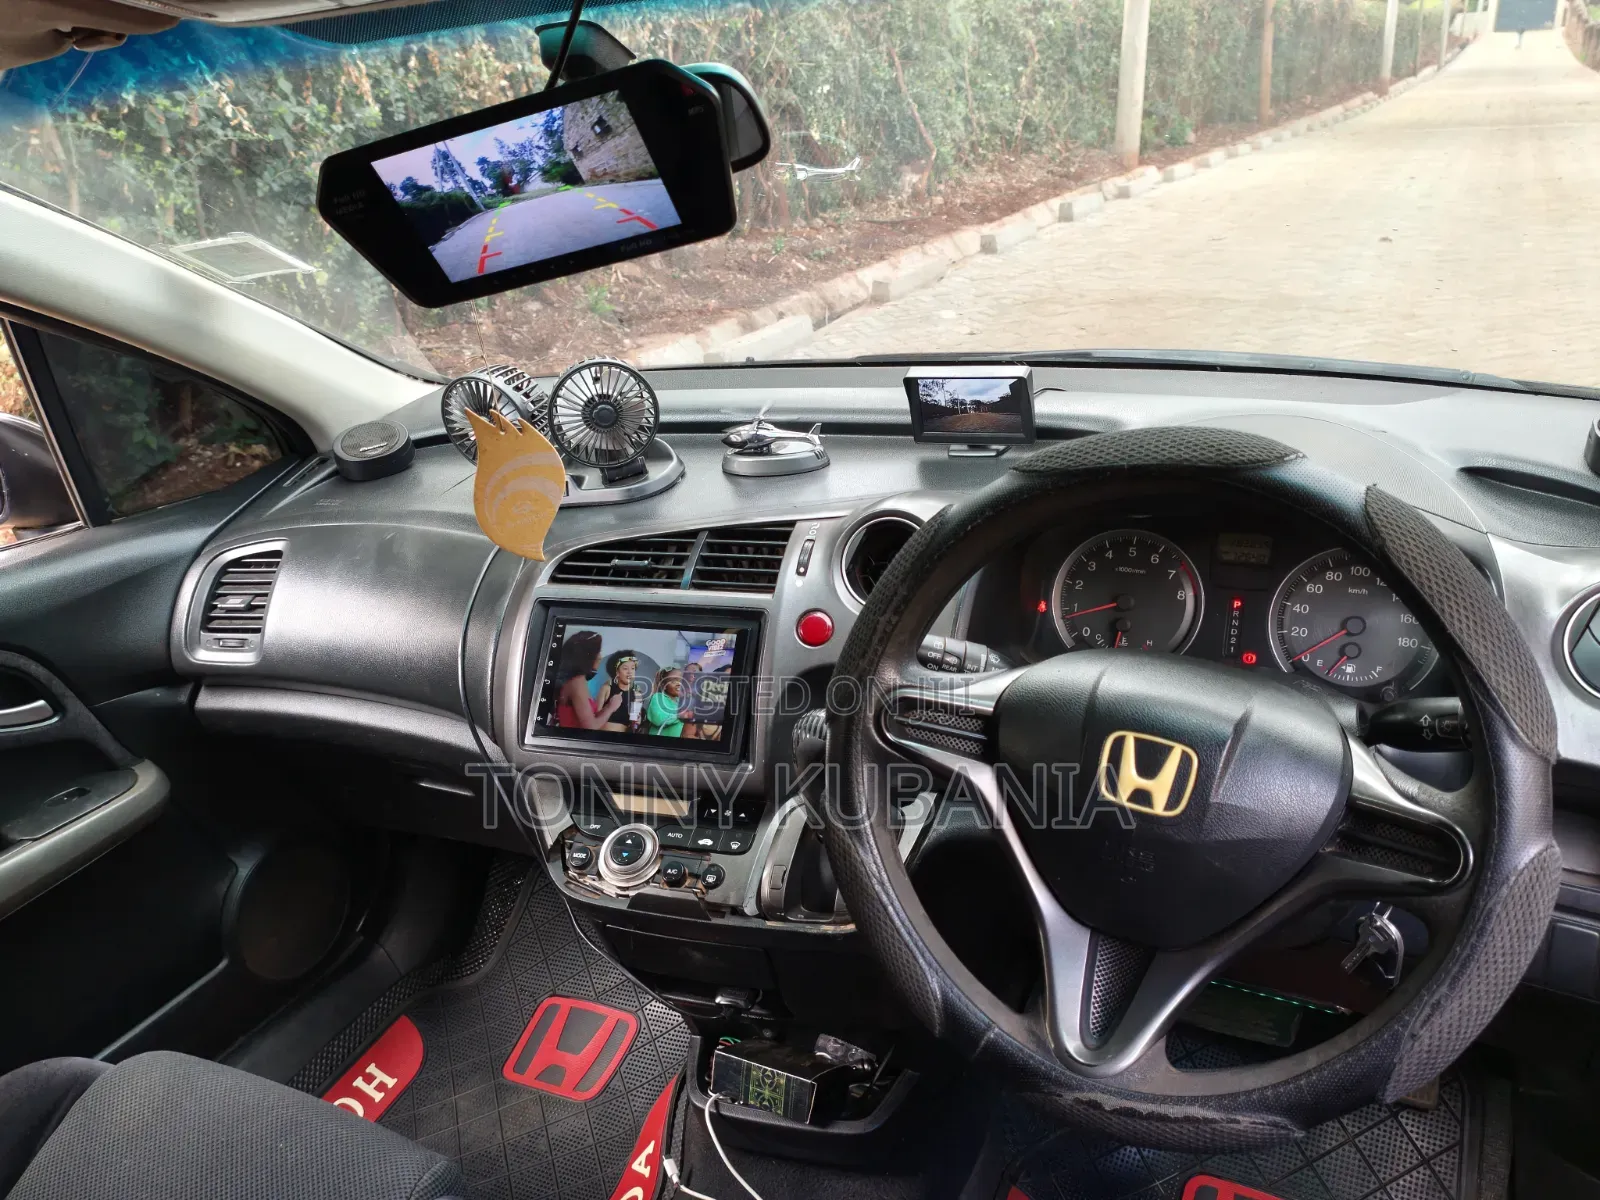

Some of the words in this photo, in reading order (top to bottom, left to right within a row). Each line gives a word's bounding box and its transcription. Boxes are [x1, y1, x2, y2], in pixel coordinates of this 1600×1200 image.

[1105, 550, 1113, 560] 4
[1129, 547, 1137, 557] 5
[1151, 554, 1160, 564] 6
[1088, 561, 1096, 572] 3
[1350, 566, 1371, 577] 100
[1167, 570, 1176, 580] 7
[1325, 572, 1343, 582] 80
[1075, 580, 1084, 590] 2
[1306, 584, 1323, 594] 60
[1177, 590, 1186, 600] 8
[1348, 587, 1369, 596] km/h
[1233, 600, 1242, 609] P
[1292, 604, 1310, 614] 40
[1082, 626, 1091, 637] 0
[1291, 627, 1308, 637] 20
[1397, 637, 1418, 648] 180
[927, 651, 942, 660] OFF
[1301, 653, 1310, 662] 0
[927, 663, 939, 671] ON
[966, 663, 979, 672] INT
[1316, 659, 1323, 667] E
[941, 664, 958, 673] REAR
[1376, 665, 1383, 673] F
